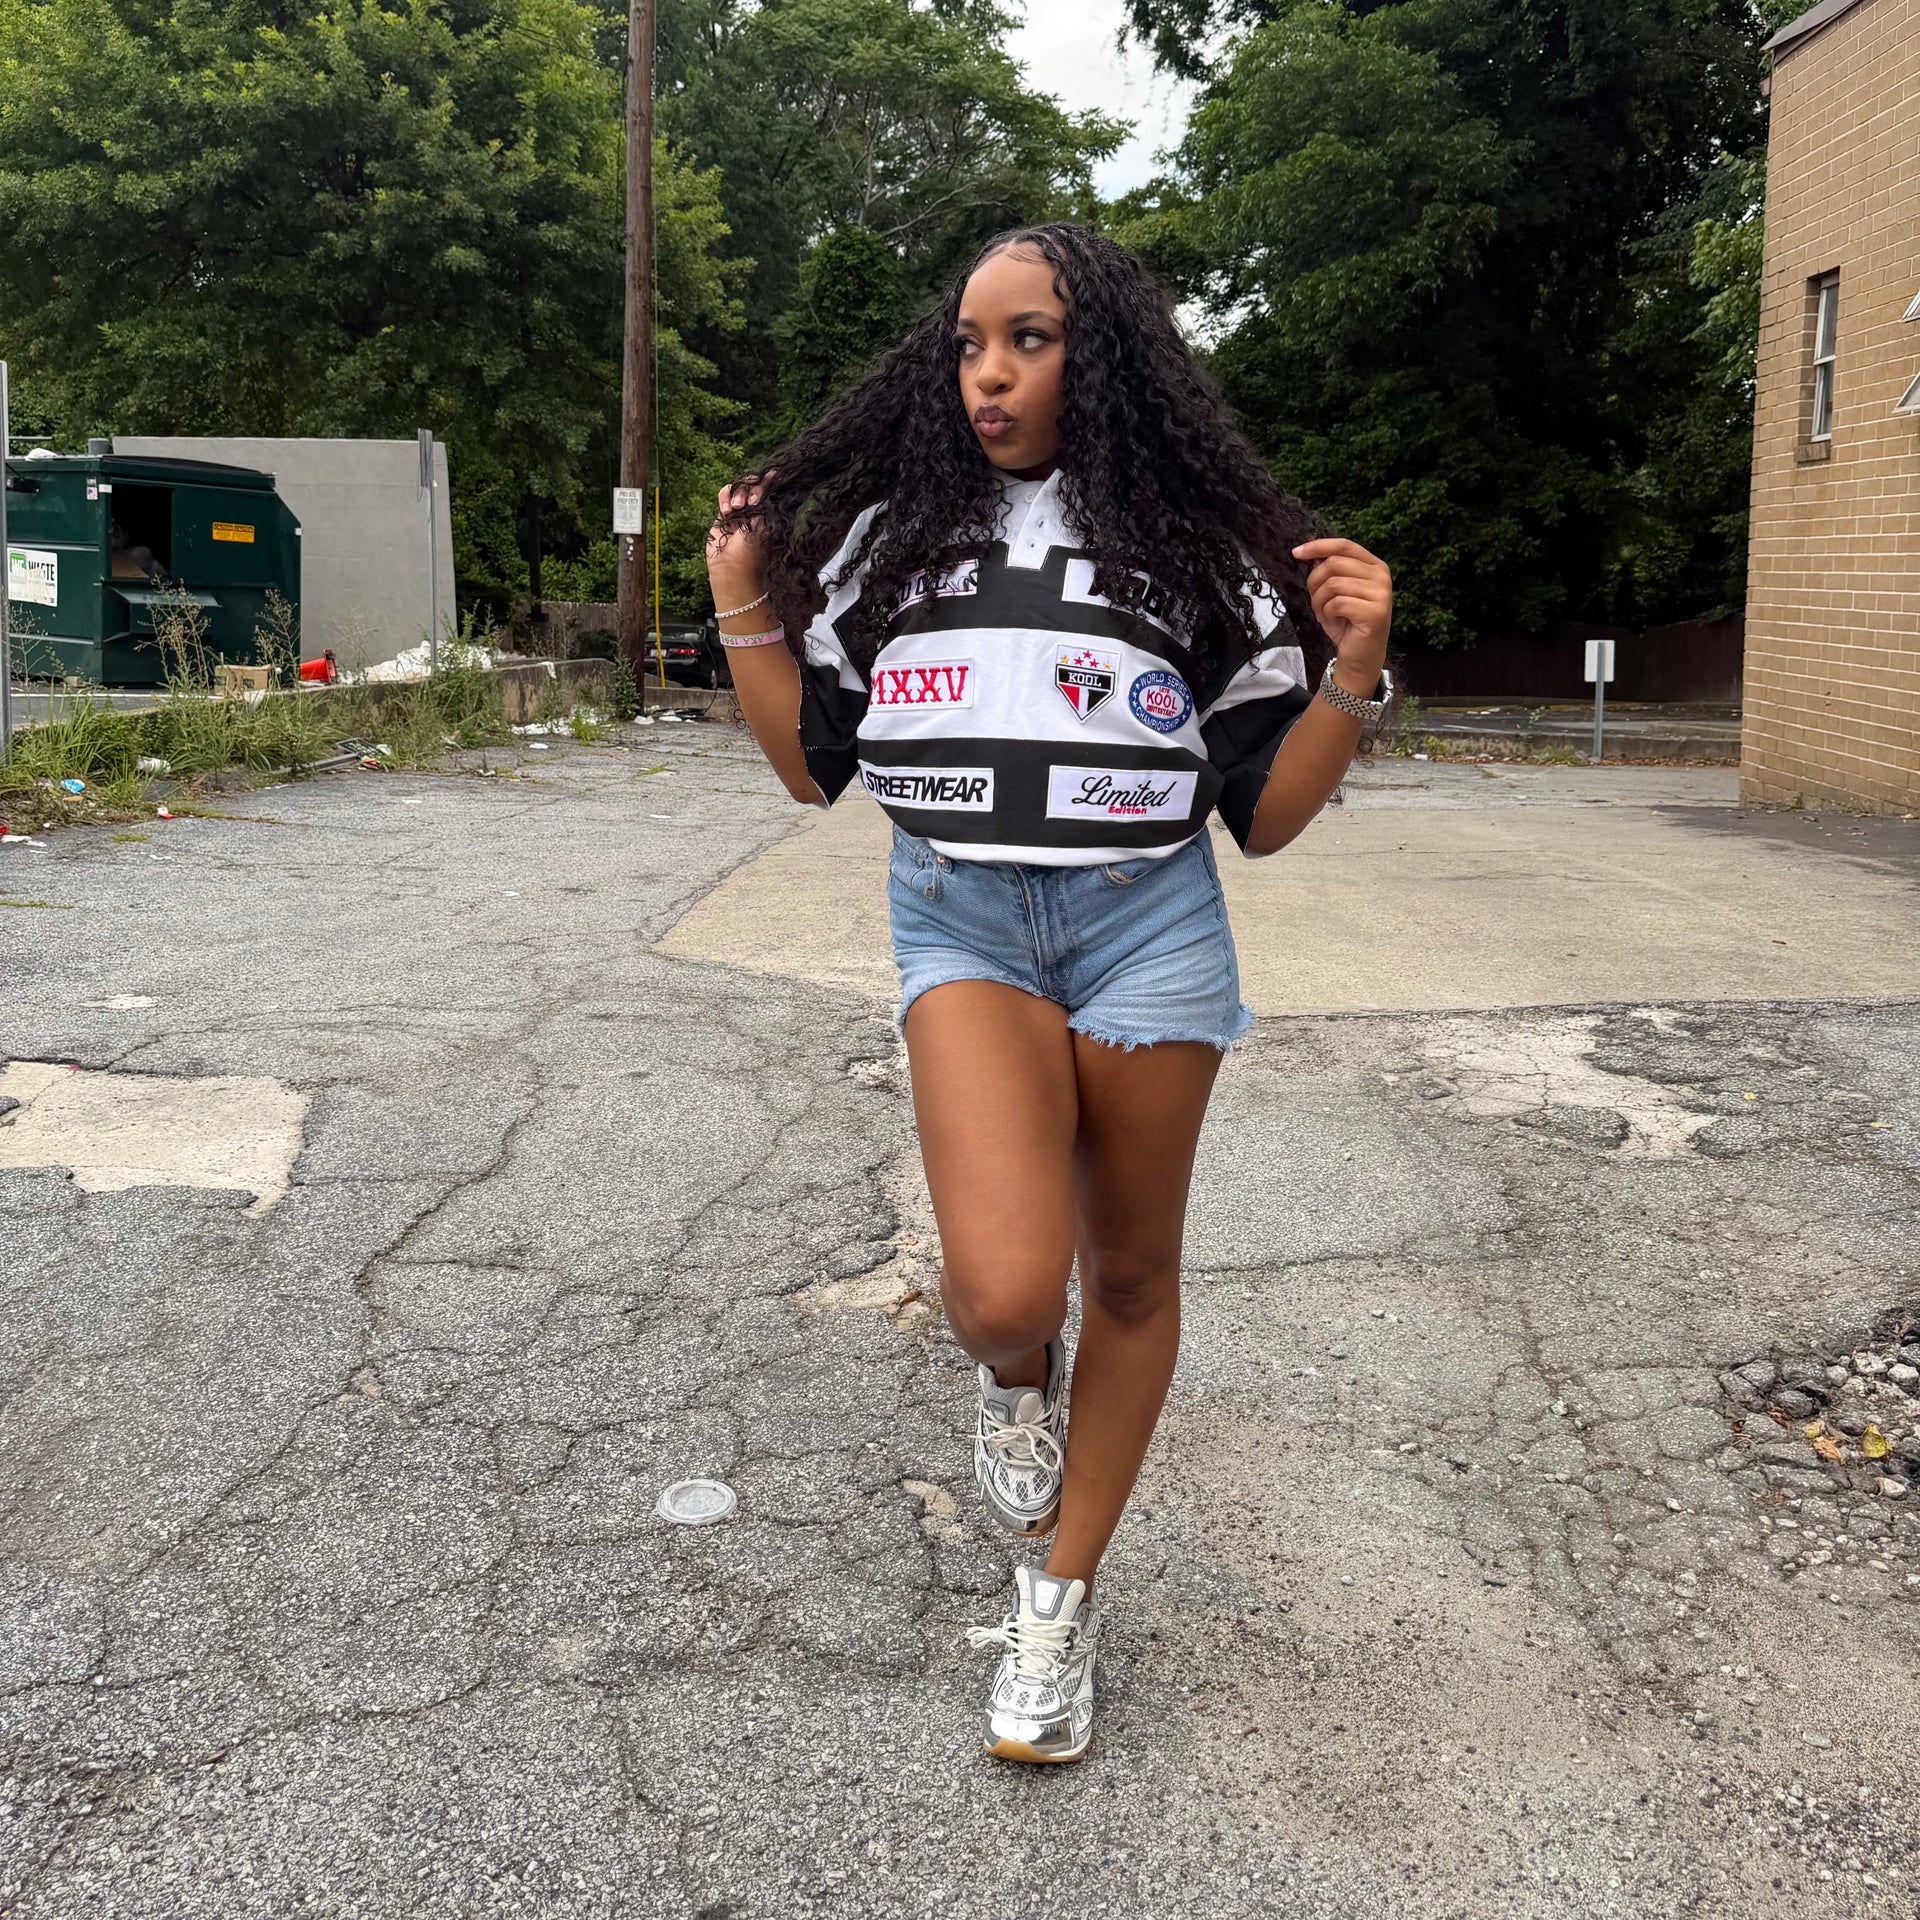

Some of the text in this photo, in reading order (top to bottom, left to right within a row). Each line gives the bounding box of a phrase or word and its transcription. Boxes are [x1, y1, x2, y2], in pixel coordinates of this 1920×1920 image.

[743, 635, 764, 645] AKA
[1067, 672, 1102, 688] KOOL
[1140, 673, 1187, 697] WORLD SERIES
[1146, 689, 1178, 711] KOOL
[1136, 706, 1180, 731] CHAMPIONSHIP
[866, 770, 988, 803] STREETWEAR
[1071, 775, 1177, 807] Limited
[1108, 805, 1147, 815] Edition
